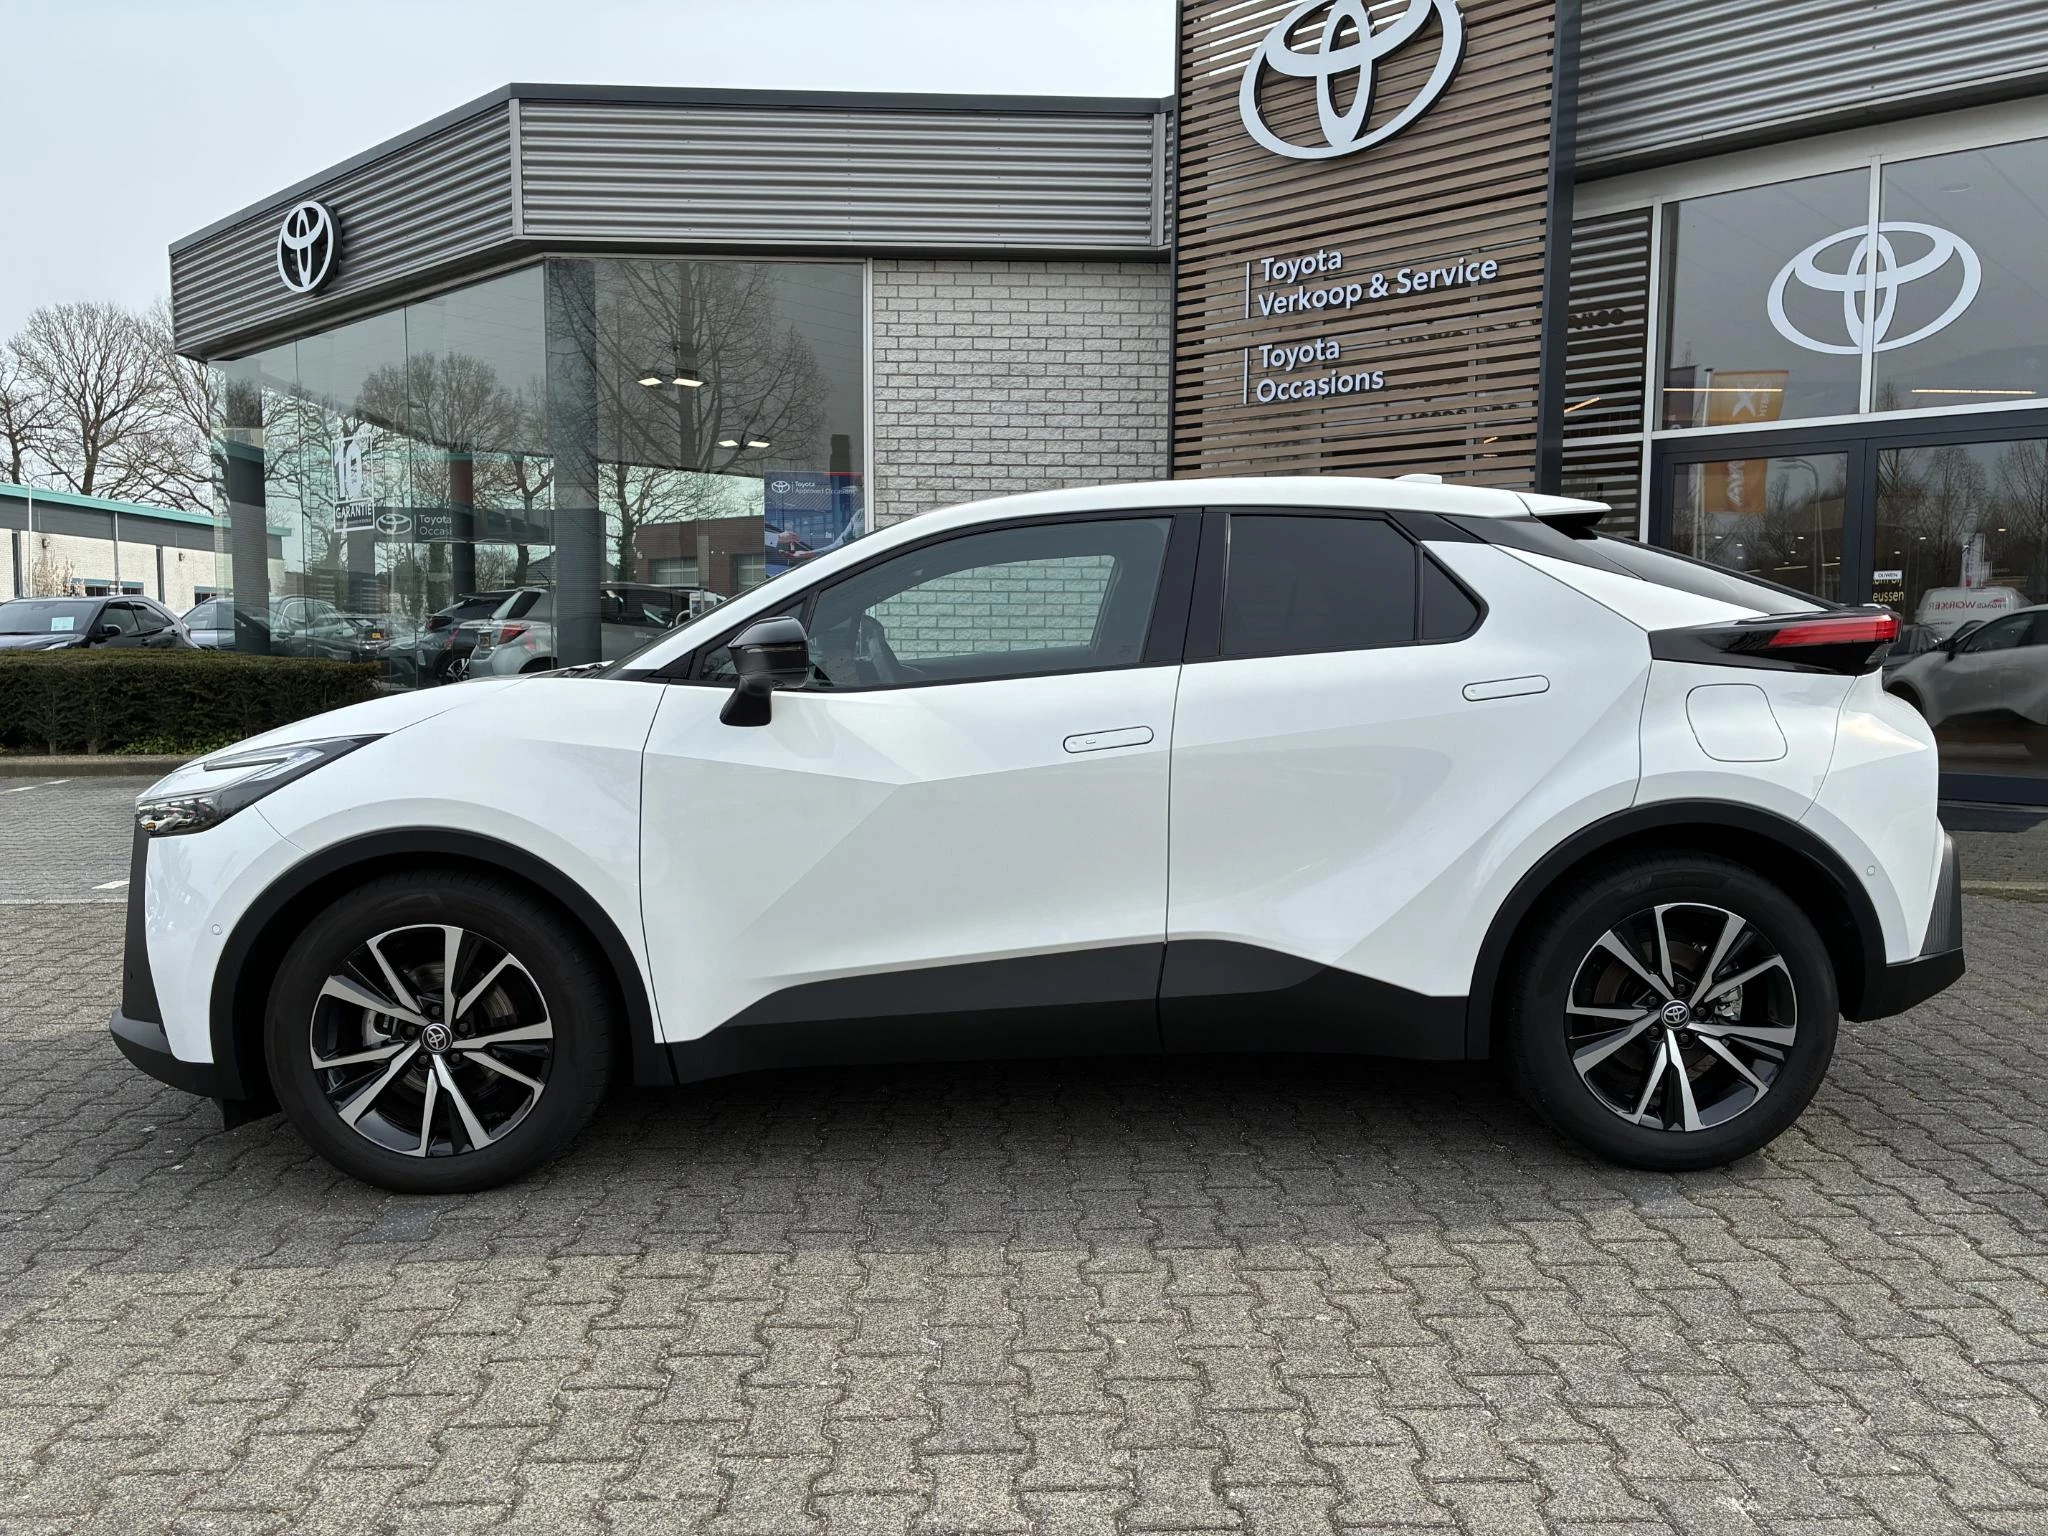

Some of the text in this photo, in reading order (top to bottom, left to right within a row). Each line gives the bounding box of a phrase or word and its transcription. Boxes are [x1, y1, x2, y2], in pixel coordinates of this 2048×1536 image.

[1260, 249, 1343, 283] Toyota
[1258, 257, 1499, 316] Verkoop & Service
[1258, 338, 1341, 372] Toyota
[1256, 369, 1386, 403] Occasions
[335, 503, 372, 519] GARANTIE
[419, 514, 452, 526] Toyota
